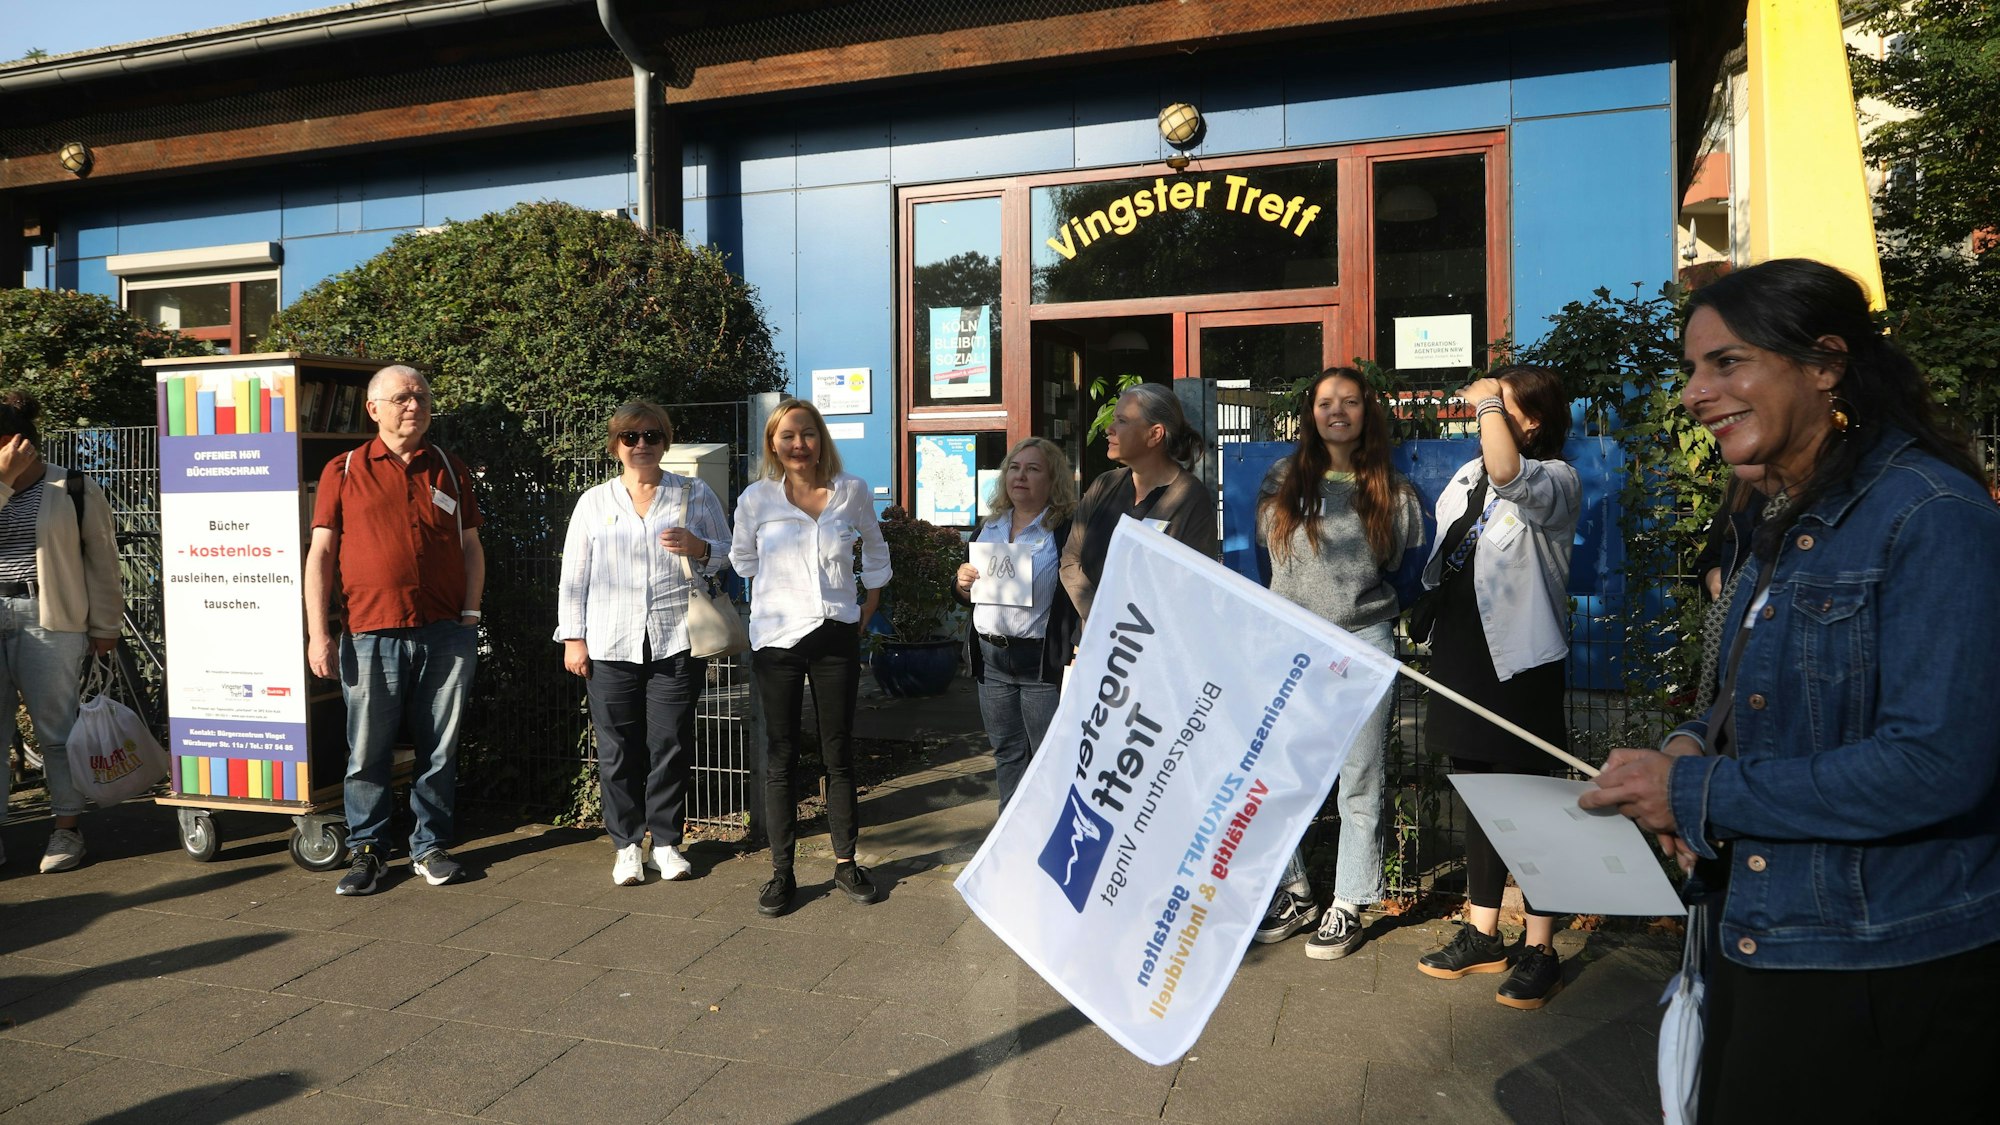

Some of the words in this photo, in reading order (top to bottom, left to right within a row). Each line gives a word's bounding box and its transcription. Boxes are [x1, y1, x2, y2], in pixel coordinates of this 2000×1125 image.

[1046, 177, 1211, 260] Vingster
[1225, 174, 1321, 237] Treff
[934, 335, 986, 349] BLEIB(T)
[936, 352, 985, 366] SOZIAL!
[194, 450, 238, 461] OFFENER
[239, 449, 260, 459] HöVi
[186, 465, 270, 477] BÜCHERSCHRANK
[209, 520, 250, 531] Bücher
[190, 544, 272, 557] kostenlos
[170, 572, 228, 585] ausleihen,
[232, 572, 294, 585] einstellen,
[204, 598, 260, 609] tauschen.
[189, 728, 216, 737] Kontakt:
[217, 730, 264, 739] Bürgerzentrum
[265, 732, 286, 740] Vingst
[182, 739, 218, 748] Würzburger
